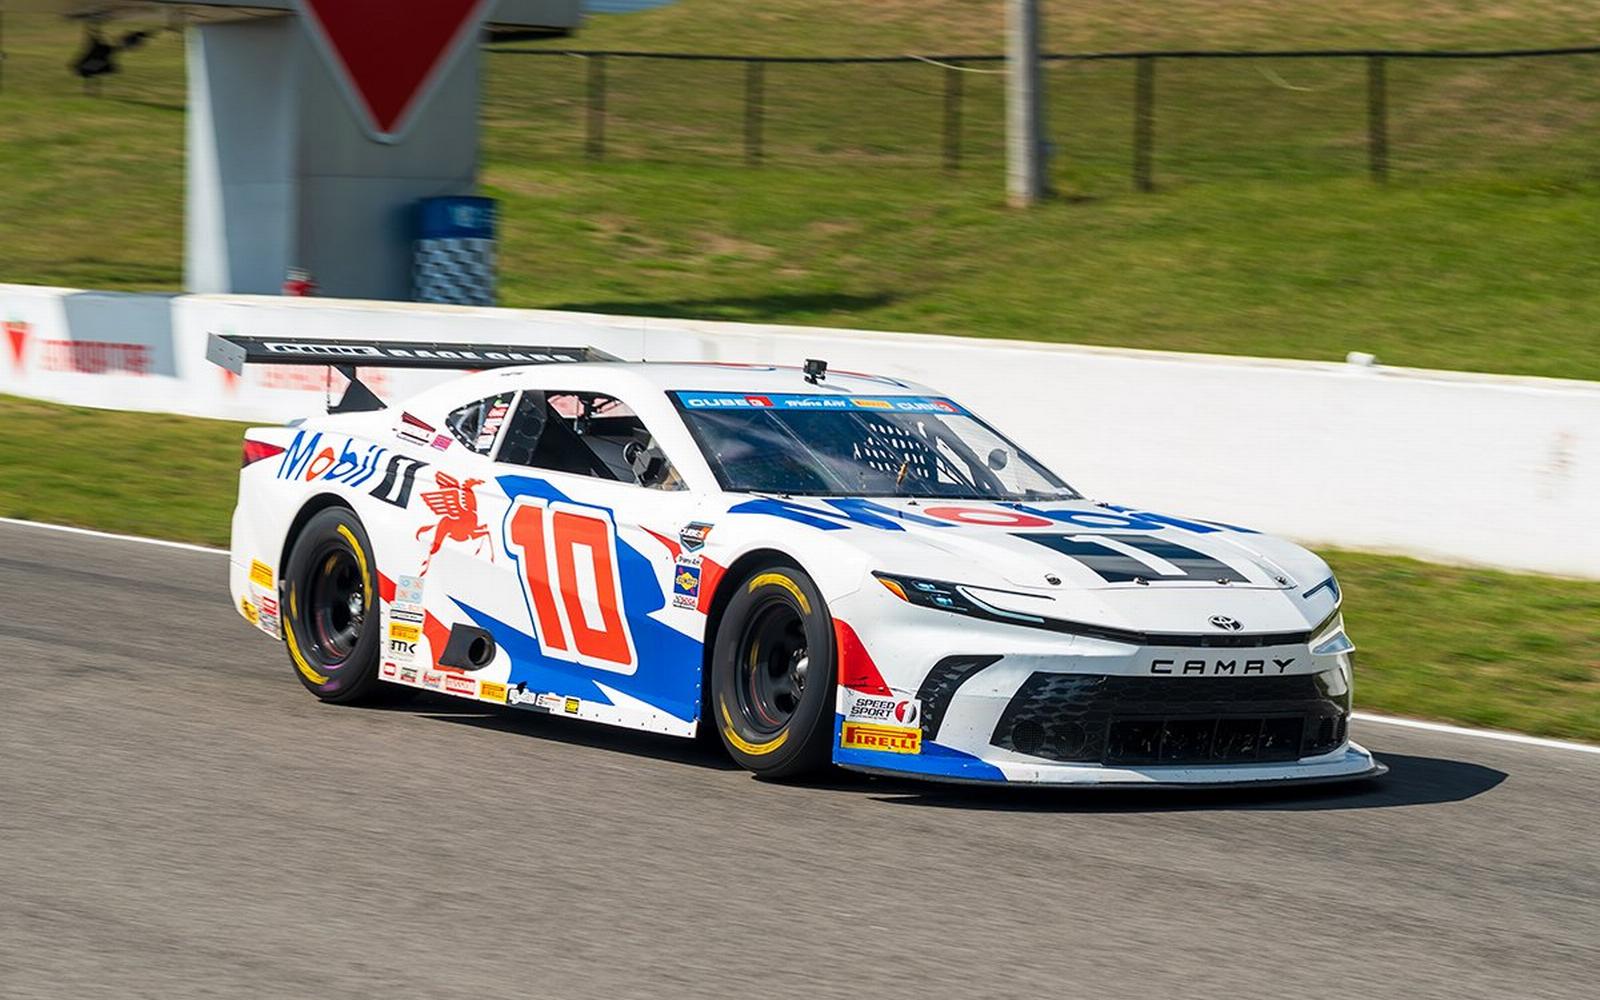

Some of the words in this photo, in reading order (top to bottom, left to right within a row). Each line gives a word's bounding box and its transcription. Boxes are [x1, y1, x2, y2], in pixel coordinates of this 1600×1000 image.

[277, 430, 388, 488] Mobil
[510, 503, 632, 666] 10
[1150, 658, 1296, 674] CAMRY
[850, 705, 893, 718] SPORT
[855, 698, 896, 710] SPEED
[845, 726, 918, 750] PIRELLI
